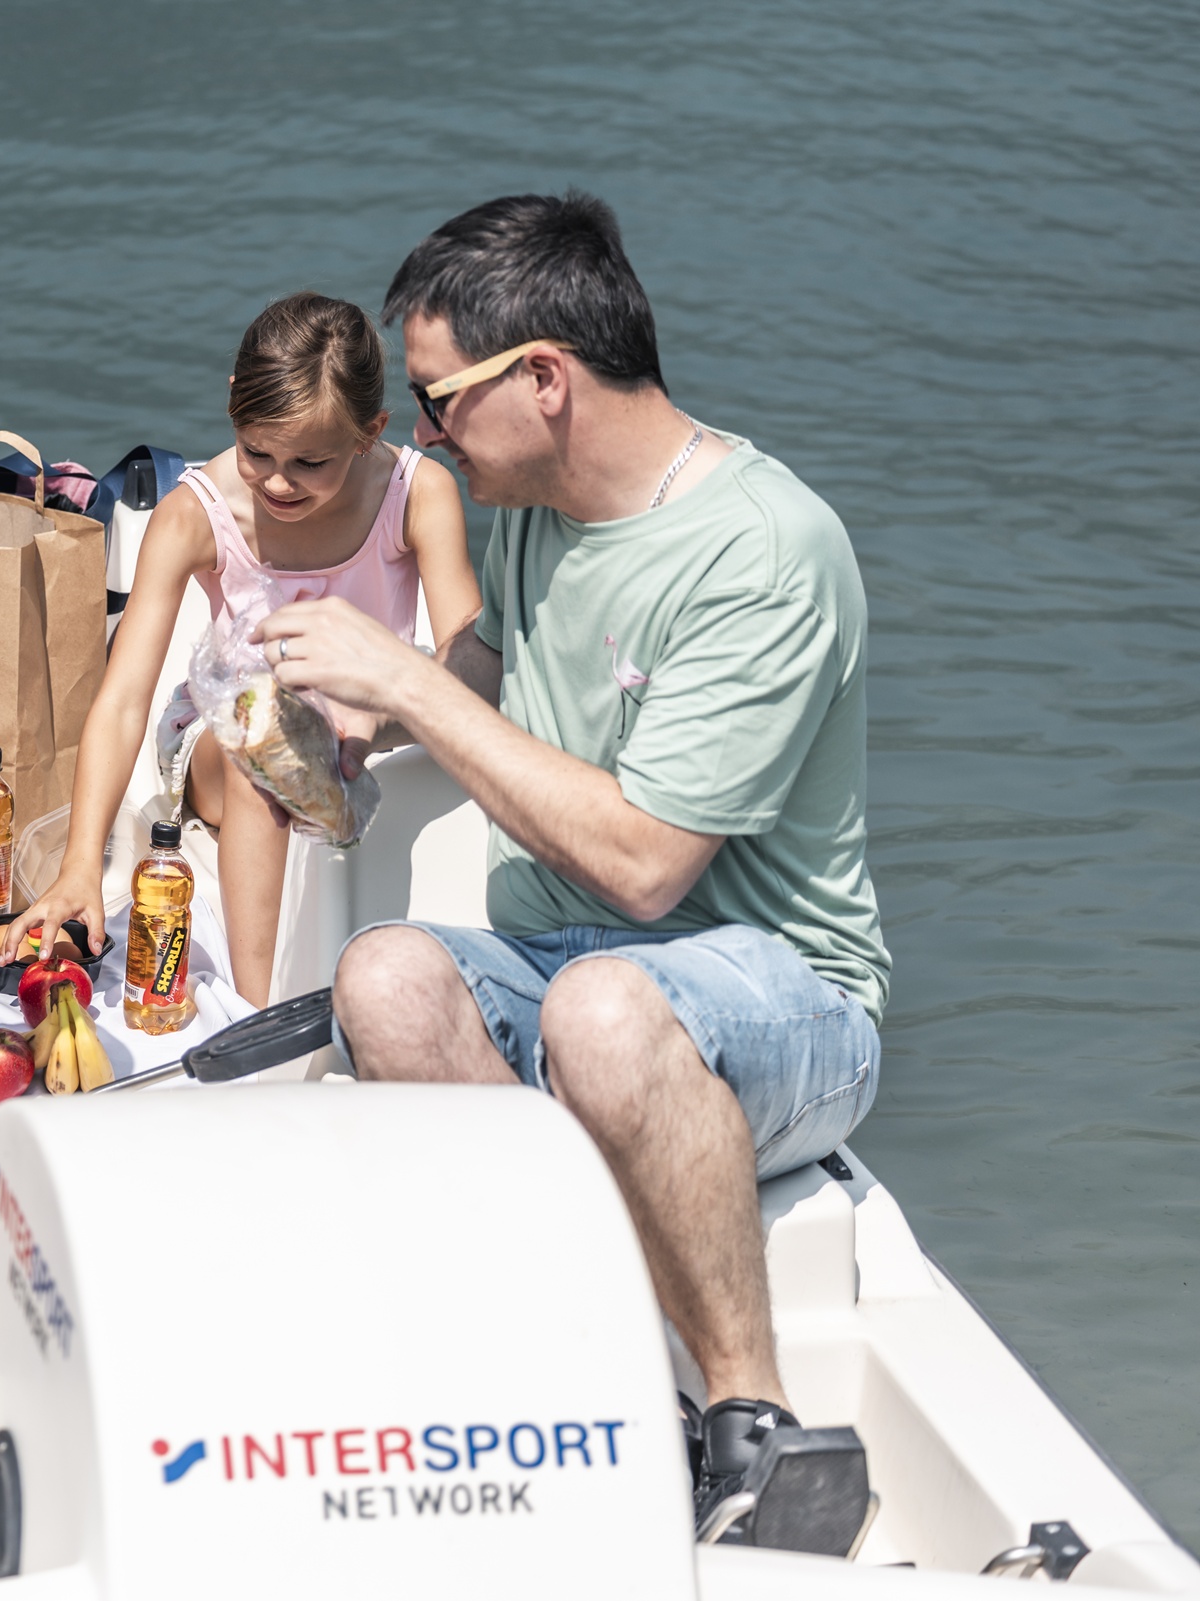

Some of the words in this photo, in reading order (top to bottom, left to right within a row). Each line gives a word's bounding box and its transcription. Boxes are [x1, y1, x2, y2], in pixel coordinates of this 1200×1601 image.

[156, 930, 185, 993] SHORLEY
[221, 1419, 625, 1481] INTERSPORT
[322, 1481, 533, 1520] NETWORK
